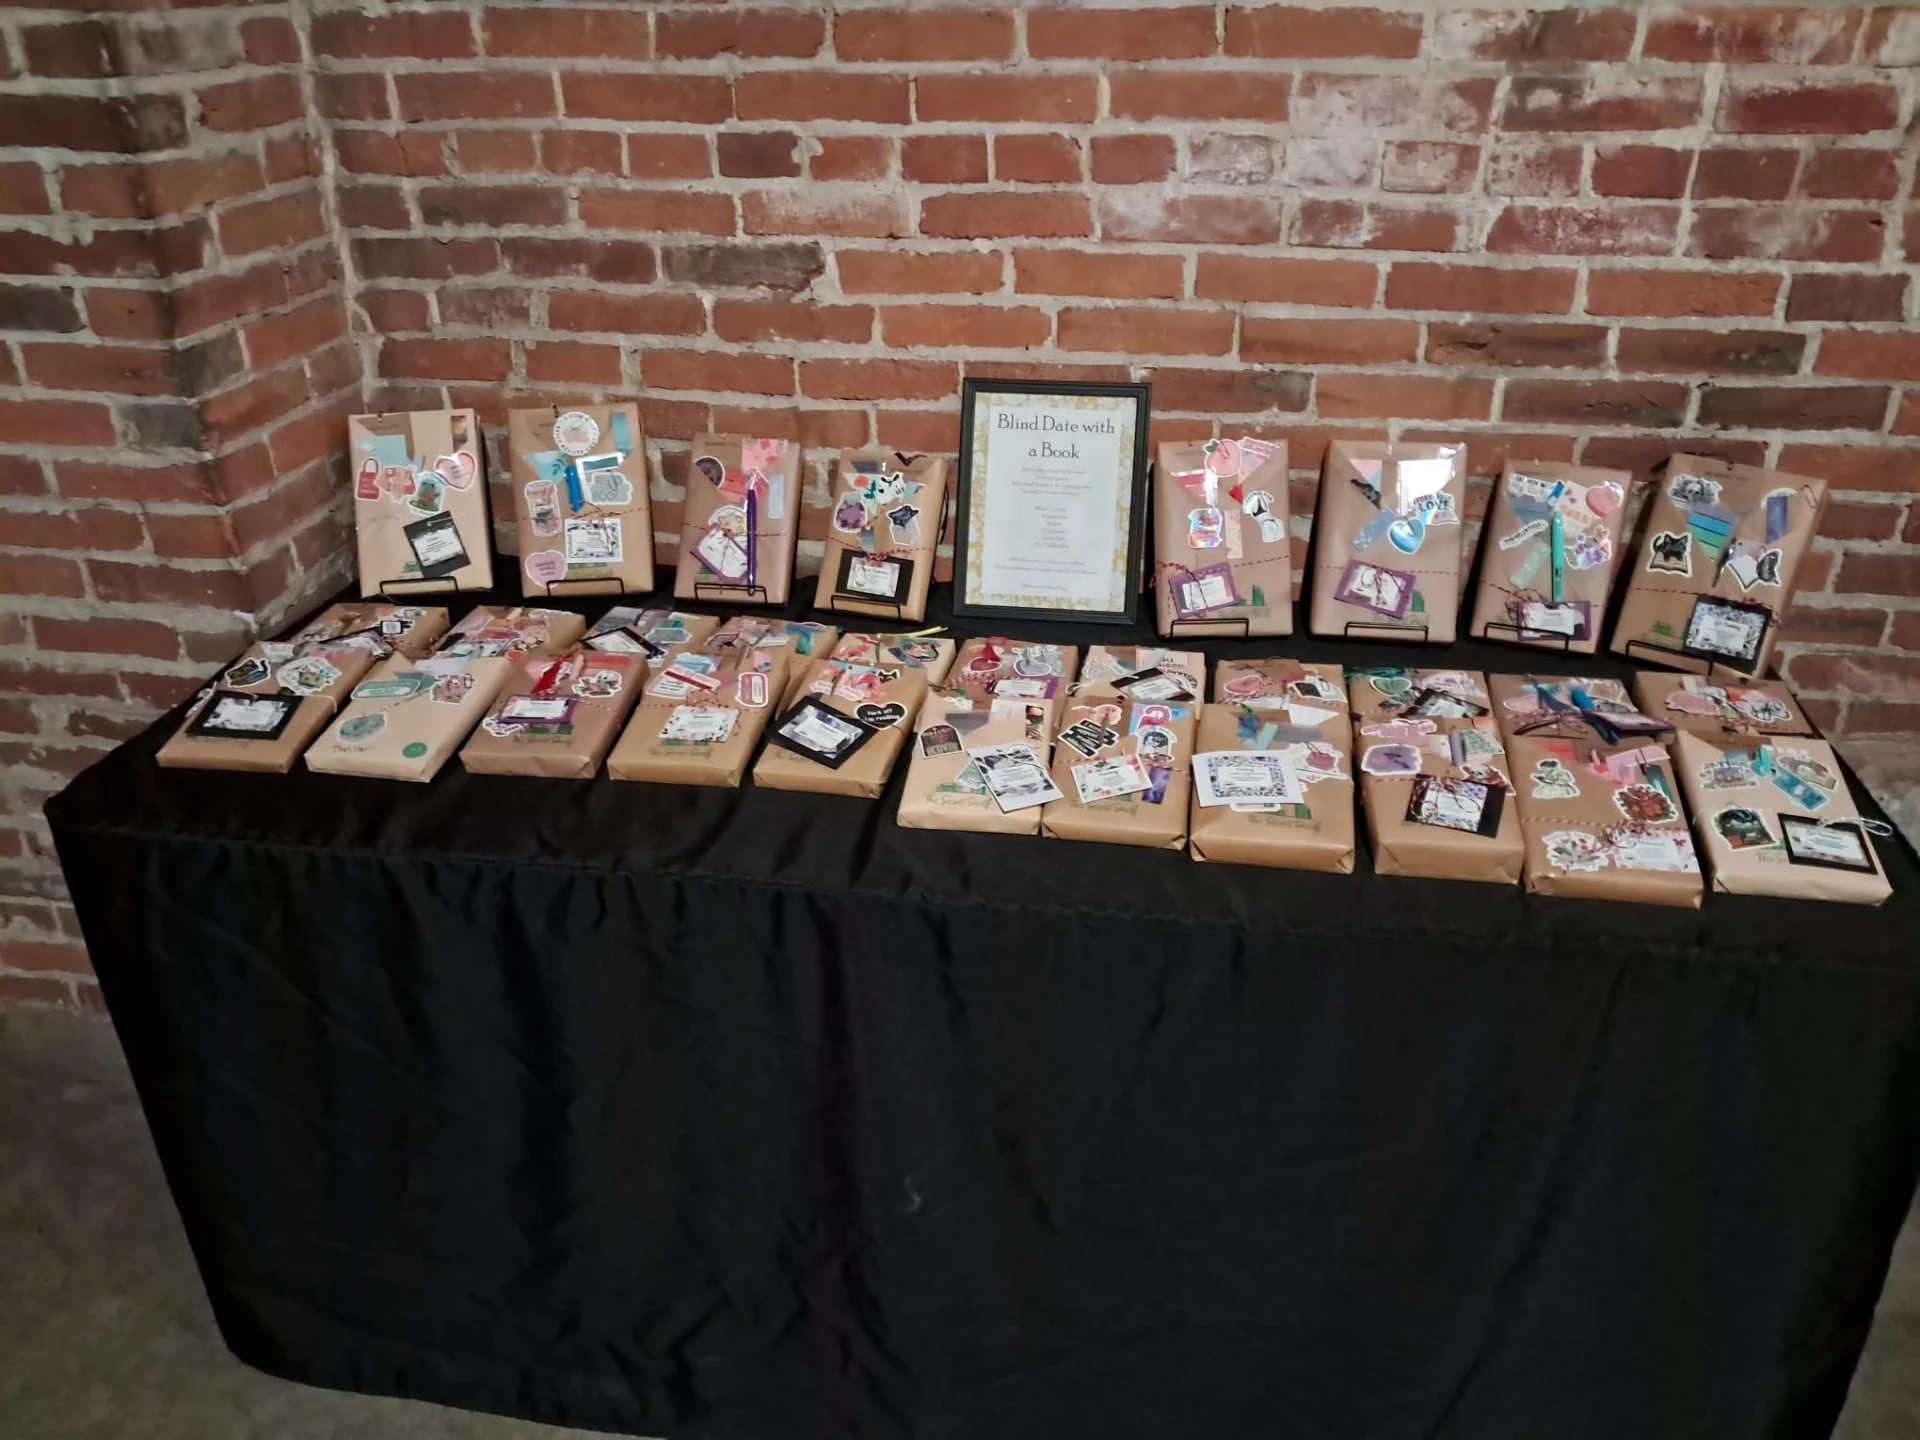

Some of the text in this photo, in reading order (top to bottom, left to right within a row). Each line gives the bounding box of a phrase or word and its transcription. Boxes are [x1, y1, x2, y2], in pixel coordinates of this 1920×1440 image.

[997, 413, 1115, 434] Blind Date with
[1028, 441, 1080, 459] a Book
